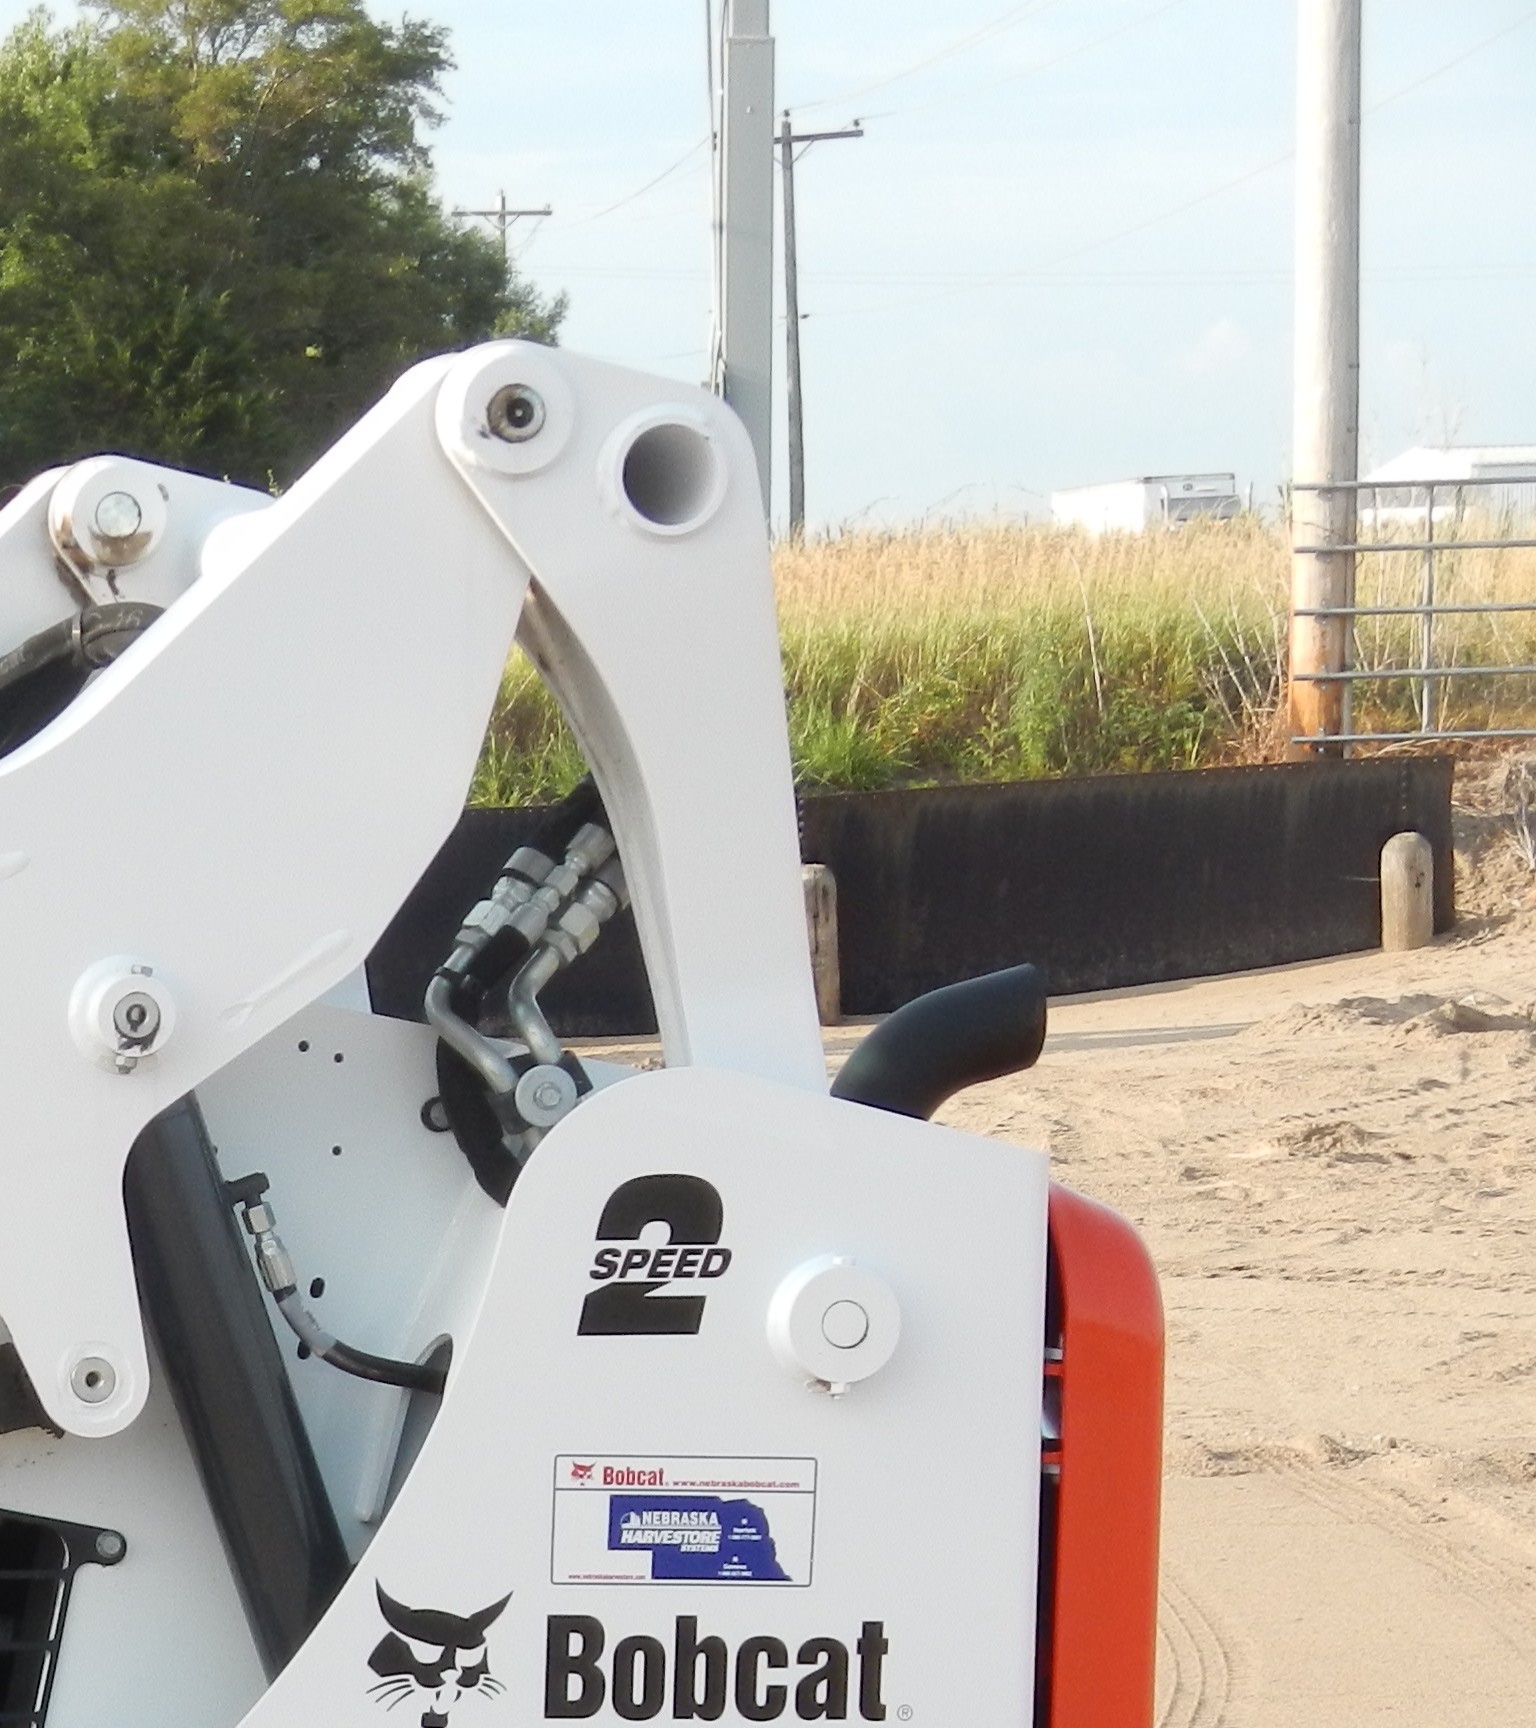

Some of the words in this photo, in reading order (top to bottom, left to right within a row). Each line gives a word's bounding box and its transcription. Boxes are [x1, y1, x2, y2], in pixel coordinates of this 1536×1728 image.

[577, 1173, 723, 1336] 2
[589, 1247, 732, 1280] SPEED
[603, 1466, 664, 1487] Bobcat
[672, 1480, 800, 1488] www.nebraskabobcat.com
[642, 1510, 719, 1526] NEBRASKA
[620, 1530, 721, 1544] HARVESTORE
[544, 1614, 889, 1721] Bobcat
